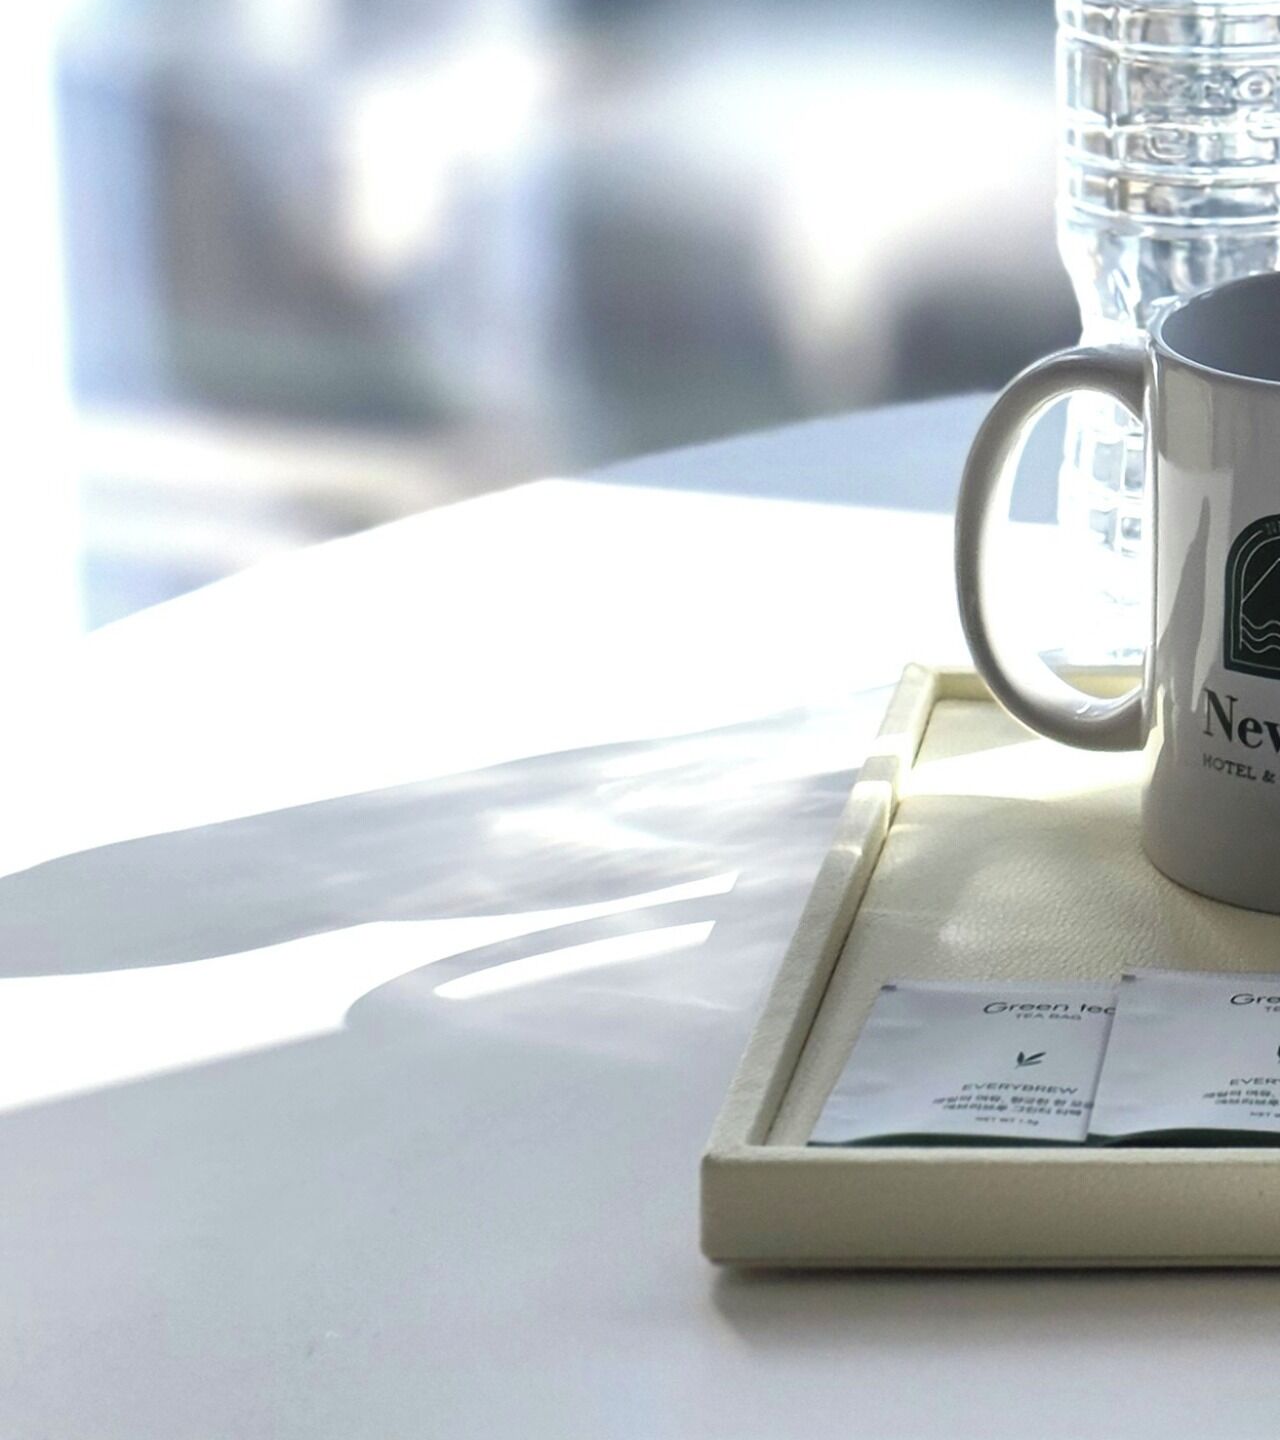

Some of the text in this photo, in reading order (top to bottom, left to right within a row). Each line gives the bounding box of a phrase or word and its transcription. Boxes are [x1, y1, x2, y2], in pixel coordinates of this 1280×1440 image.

[1202, 754, 1256, 780] HOTEL
[1262, 770, 1276, 784] &
[983, 1002, 1069, 1014] Green
[962, 1083, 1078, 1094] EVERYBREW
